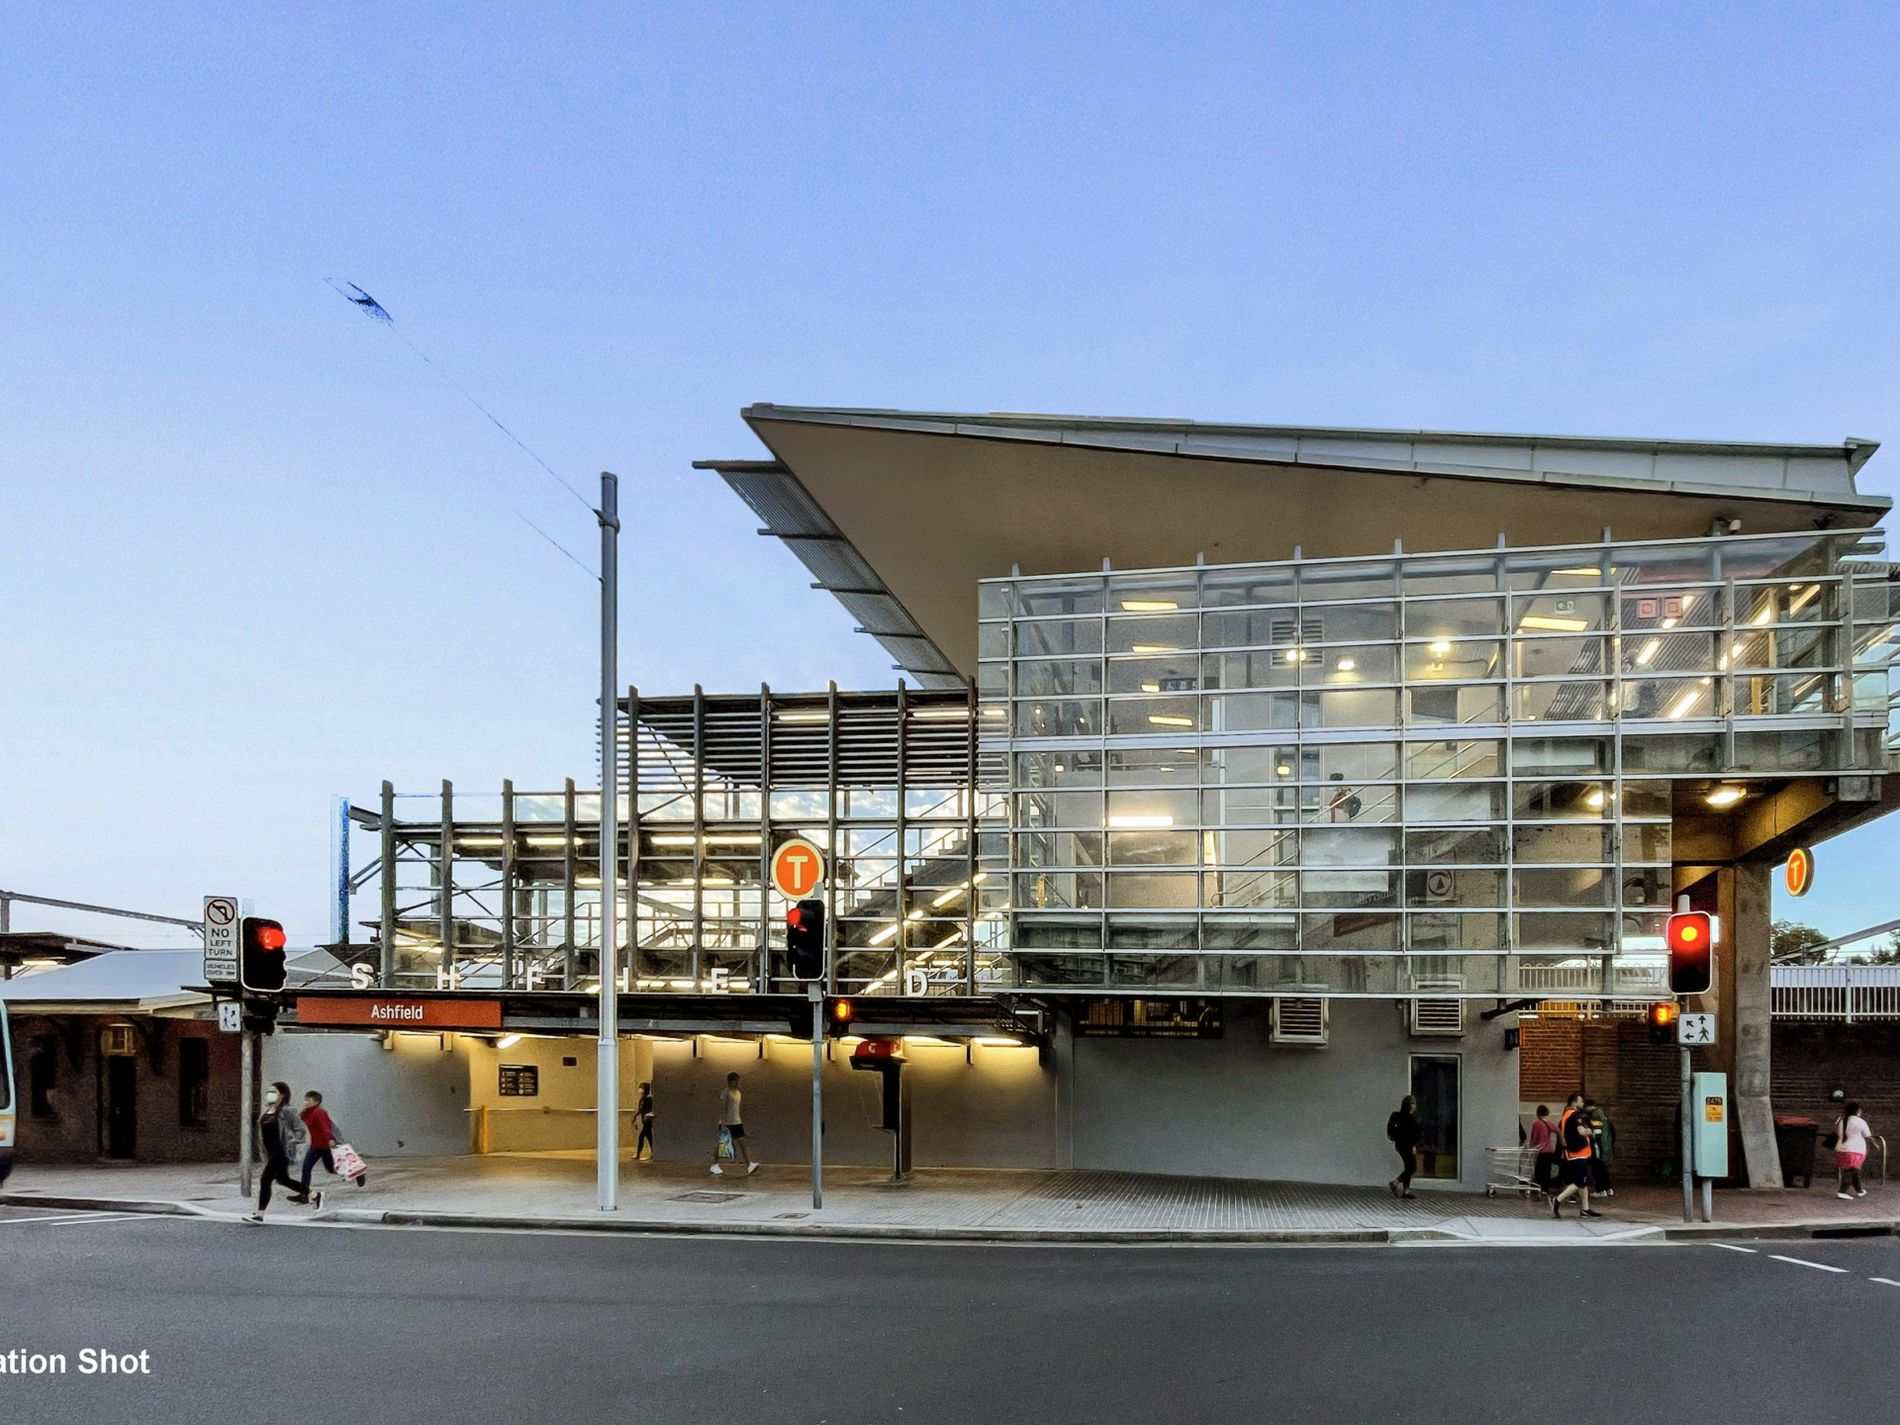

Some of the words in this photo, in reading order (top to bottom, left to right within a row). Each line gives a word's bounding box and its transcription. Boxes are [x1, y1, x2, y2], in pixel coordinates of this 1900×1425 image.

[787, 856, 808, 888] T
[1791, 860, 1800, 886] T
[211, 928, 230, 937] NO
[371, 1004, 423, 1020] Ashfield
